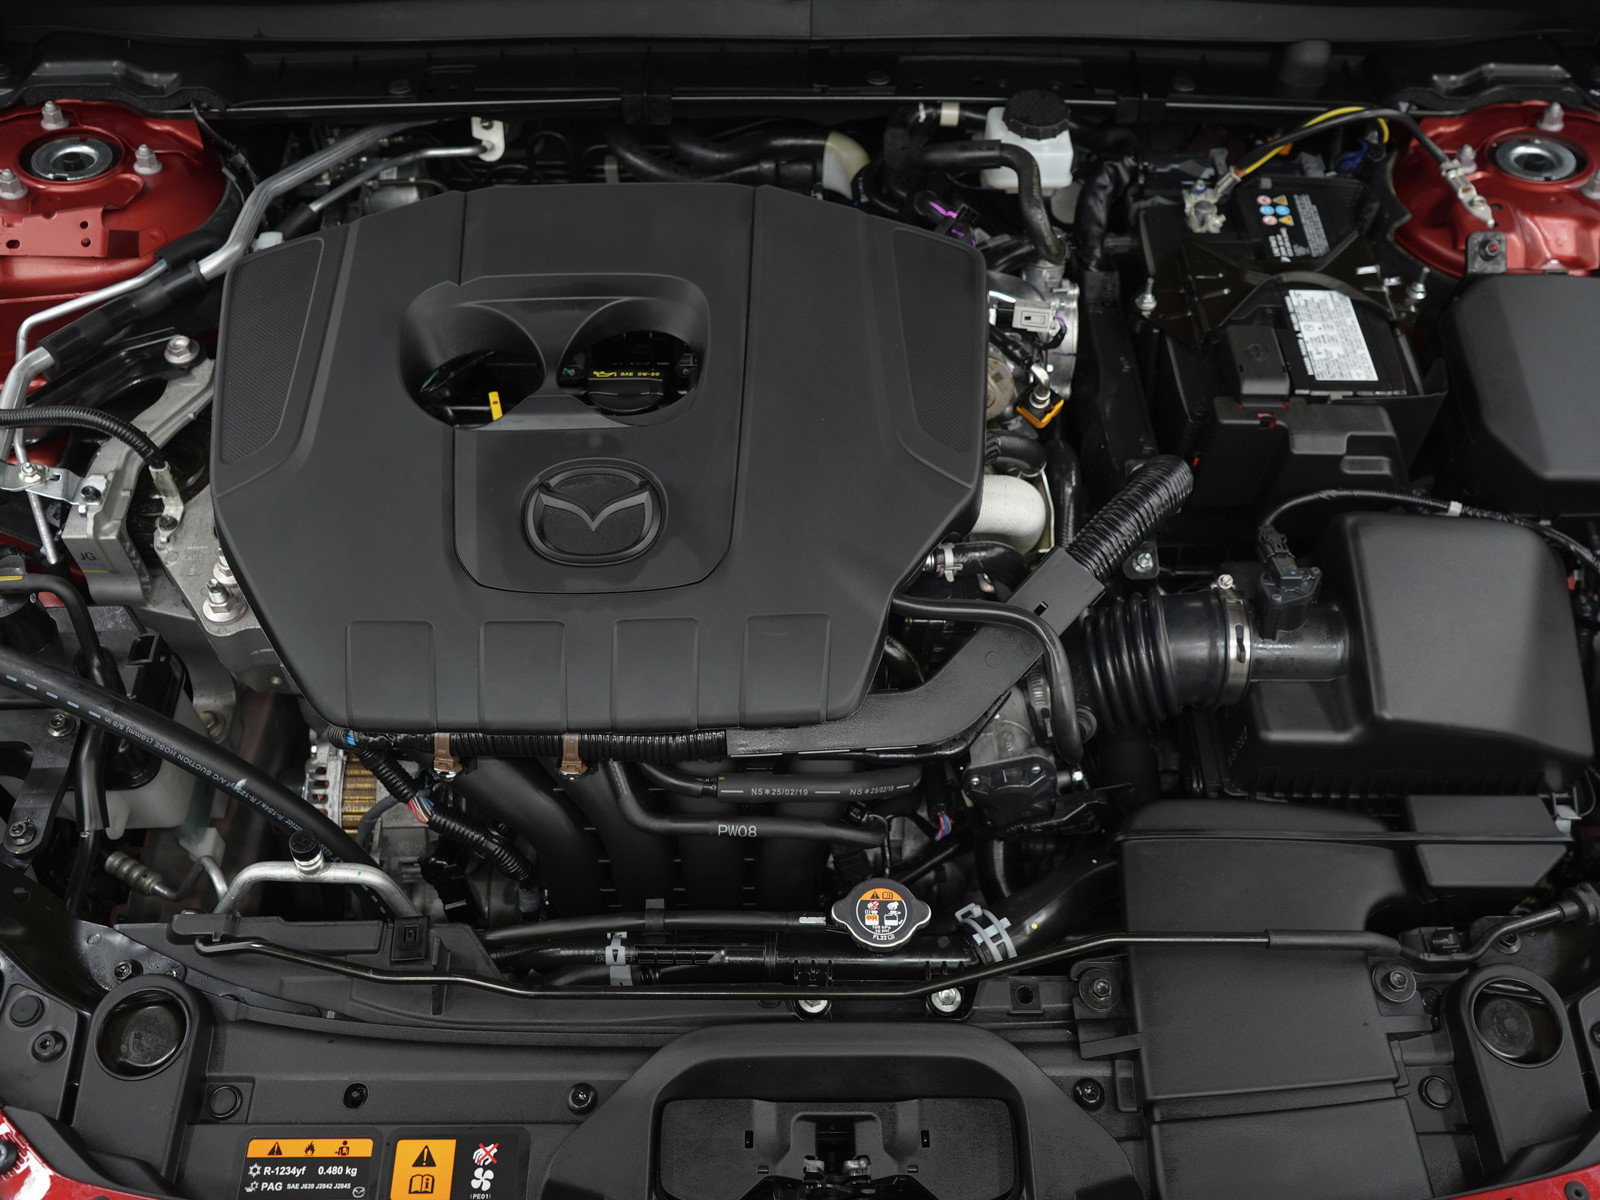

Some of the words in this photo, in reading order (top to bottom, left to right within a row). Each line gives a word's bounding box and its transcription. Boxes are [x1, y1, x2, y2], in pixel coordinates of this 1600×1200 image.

[80, 551, 96, 561] JG
[105, 717, 112, 725] in
[112, 721, 125, 730] 5/8
[125, 727, 153, 745] (16mm)
[154, 741, 176, 757] HOSE
[178, 754, 212, 777] SUCTION
[212, 773, 228, 784] A/C
[260, 803, 284, 821] R-134a
[717, 824, 757, 838] PW08
[263, 1166, 307, 1177] R-1234yf
[317, 1166, 343, 1176] 0.480
[345, 1166, 358, 1177] kg
[260, 1182, 283, 1191] PAG
